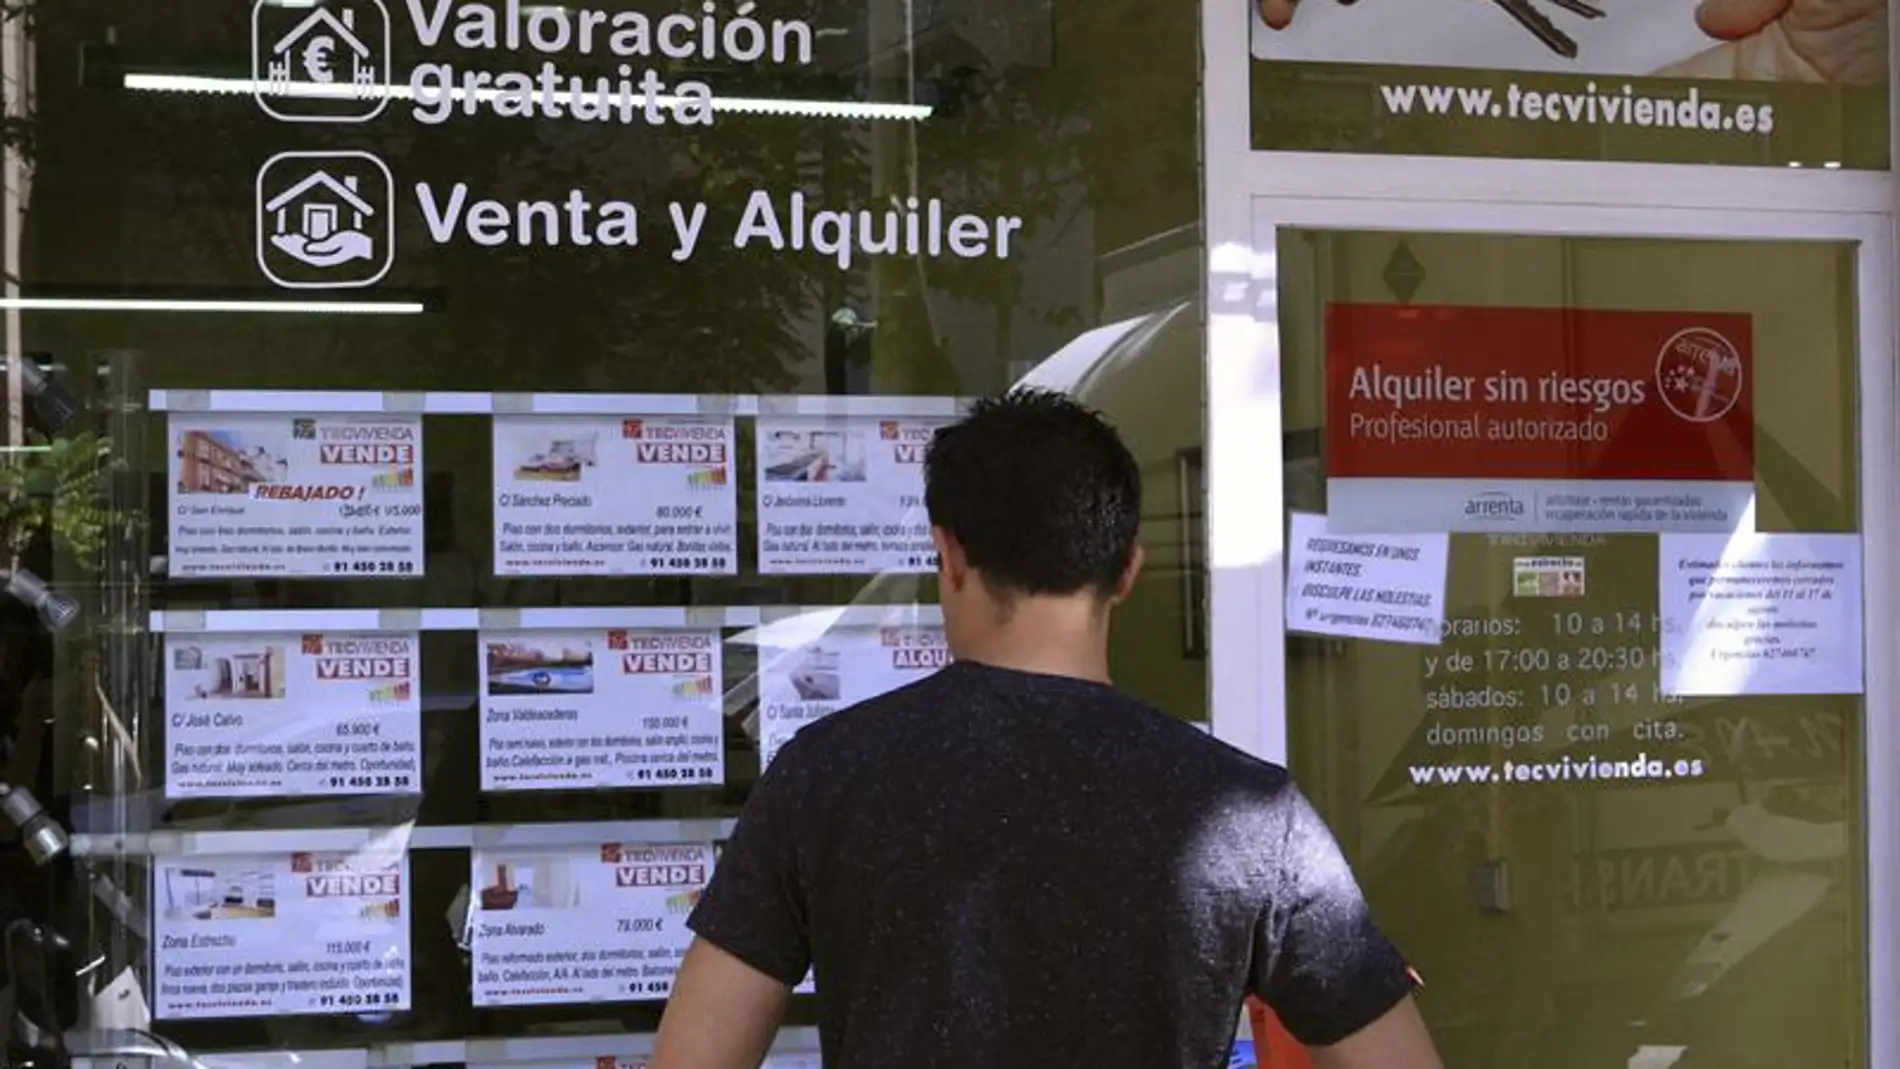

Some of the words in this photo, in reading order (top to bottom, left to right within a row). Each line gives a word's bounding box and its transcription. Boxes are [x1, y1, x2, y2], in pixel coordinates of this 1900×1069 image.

[407, 0, 812, 64] Valoración
[410, 61, 714, 126] gratuita
[1381, 82, 1774, 134] www.tecvivienda.es
[415, 182, 638, 246] Venta
[668, 202, 706, 261] y
[733, 190, 1023, 270] Alquiler
[1349, 365, 1475, 408] Alquiler
[1483, 367, 1528, 402] sin
[1538, 371, 1646, 411] riesgos
[1350, 412, 1480, 444] Profesional
[1487, 416, 1608, 442] autorizado
[322, 445, 412, 462] VENDE
[639, 444, 724, 462] VENDE
[255, 485, 355, 501] REBAJADO
[1464, 494, 1524, 516] arrenta
[1545, 508, 1616, 523] recuperación
[1655, 508, 1668, 520] de
[1671, 508, 1681, 520] la
[1684, 508, 1728, 521] vivienda
[650, 557, 664, 568] 91
[1353, 586, 1375, 603] LAS
[1553, 612, 1583, 635] 10
[1592, 618, 1604, 634] a
[1616, 611, 1642, 633] 14
[625, 654, 710, 673] VENDE
[894, 650, 948, 668] ALQU
[1425, 656, 1438, 678] y
[1446, 653, 1474, 672] de
[1484, 649, 1550, 672] 17:00
[1557, 655, 1570, 670] a
[1578, 647, 1645, 671] 20:30
[319, 659, 409, 678] VENDE
[1426, 685, 1524, 709] sábados:
[1541, 682, 1571, 706] 10
[1582, 688, 1595, 705] a
[1610, 683, 1639, 705] 14
[171, 713, 186, 727] C/
[187, 712, 210, 727] José
[213, 712, 243, 727] Calvo
[486, 708, 510, 722] Zona
[1426, 723, 1544, 749] domingos
[1566, 723, 1609, 742] con
[1633, 720, 1685, 740] cita.
[637, 769, 651, 779] 91
[1409, 752, 1704, 784] www.tecvivienda.es
[330, 776, 345, 787] 91
[618, 866, 702, 885] VENDE
[309, 876, 399, 896] VENDE
[478, 923, 503, 939] Zona
[505, 922, 546, 936] Alvarado
[655, 918, 663, 932] €
[162, 934, 188, 949] Zona
[629, 981, 643, 992] 91
[320, 995, 334, 1006] 91
